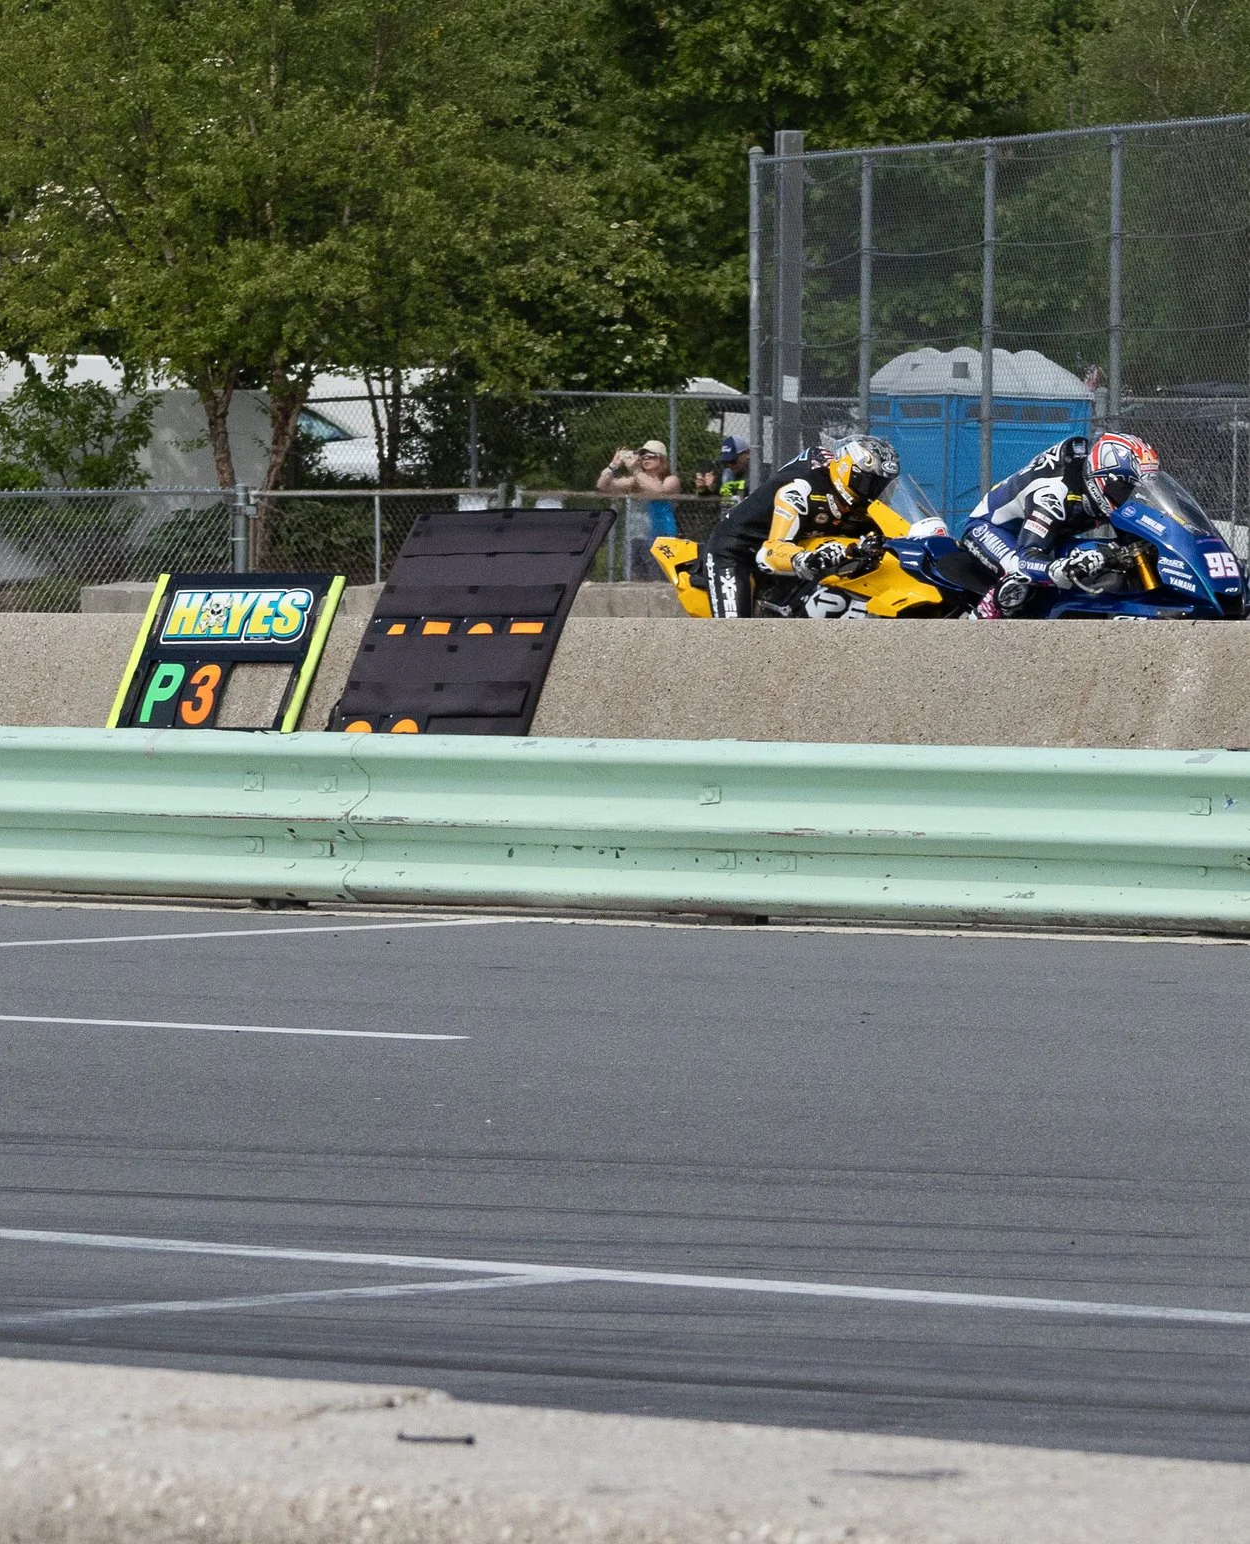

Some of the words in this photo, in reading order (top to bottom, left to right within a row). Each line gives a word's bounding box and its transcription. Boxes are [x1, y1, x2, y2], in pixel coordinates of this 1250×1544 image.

[1170, 577, 1196, 593] YAMAHA
[1203, 552, 1240, 578] 95
[163, 590, 309, 637] HAYES
[720, 575, 738, 618] XPEL
[139, 662, 222, 725] P3
